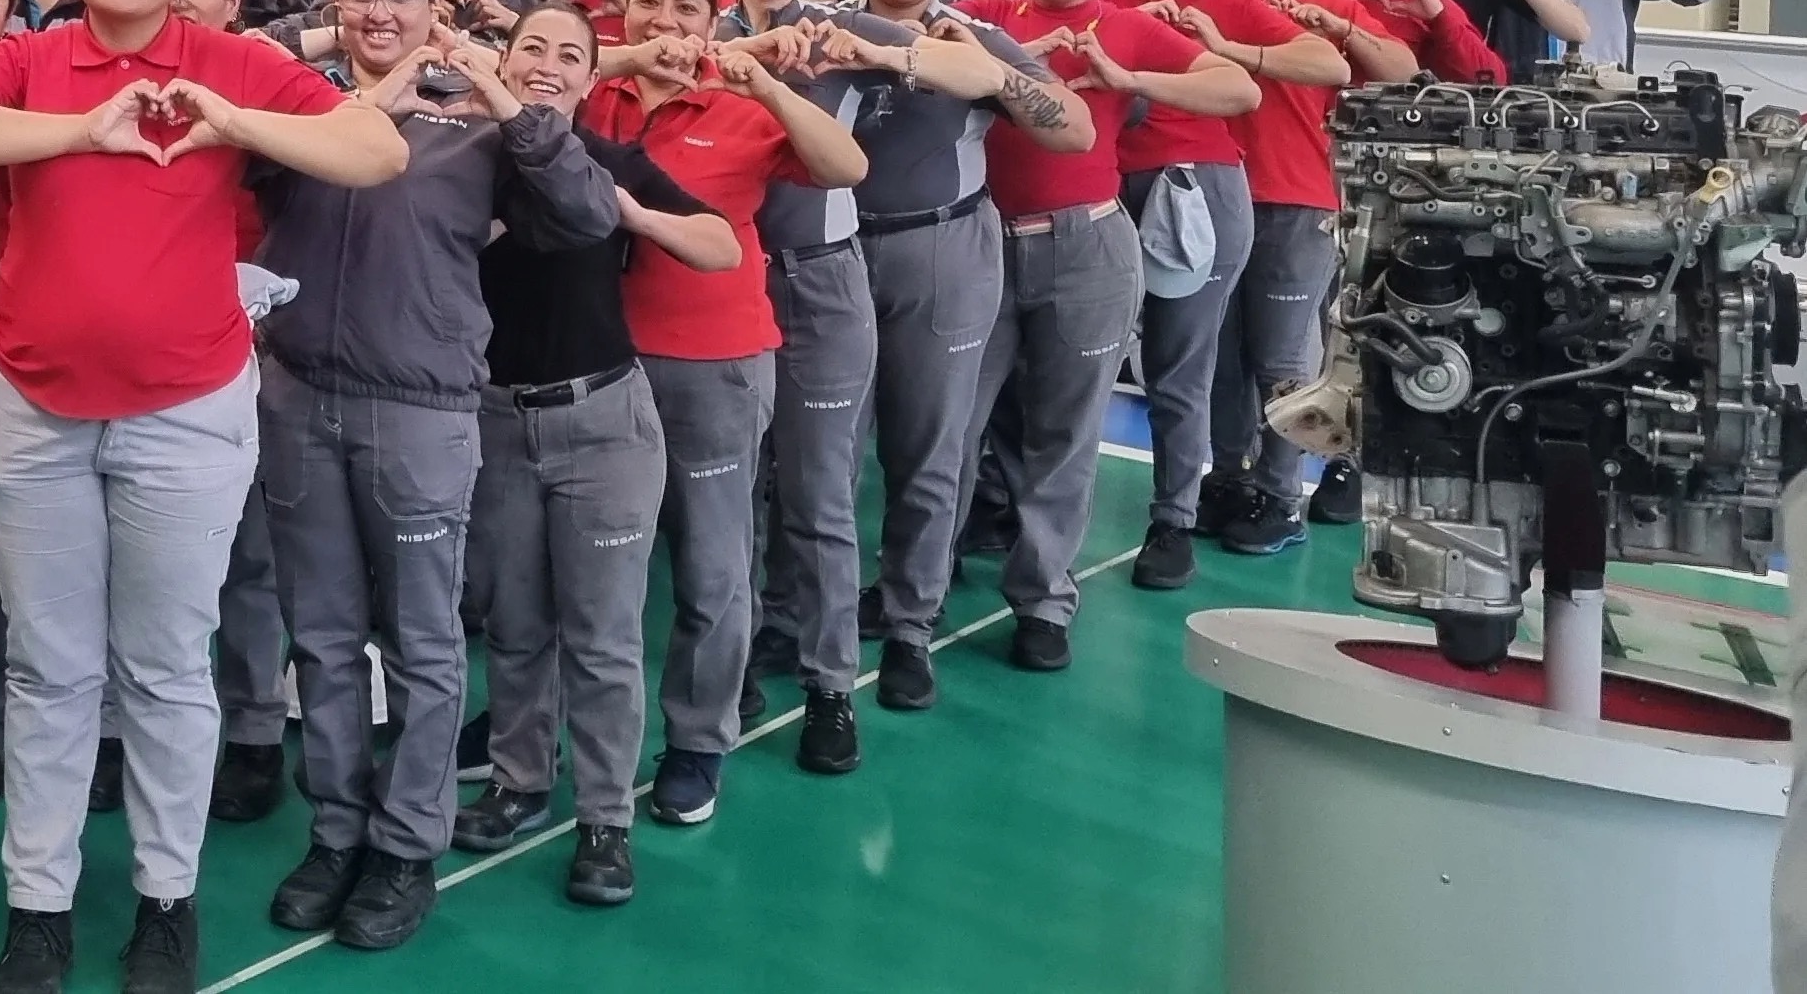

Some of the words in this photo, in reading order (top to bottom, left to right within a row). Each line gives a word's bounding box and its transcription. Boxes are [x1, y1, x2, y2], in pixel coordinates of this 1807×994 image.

[415, 112, 468, 129] NISSAN
[1267, 293, 1309, 301] NISSAN
[948, 339, 983, 354] NISSAN
[1081, 341, 1120, 357] NISSAN
[804, 398, 852, 410] NISSAN
[690, 462, 739, 479] NISSAN
[397, 526, 448, 543] NISSAN
[594, 530, 646, 548] NISSAN
